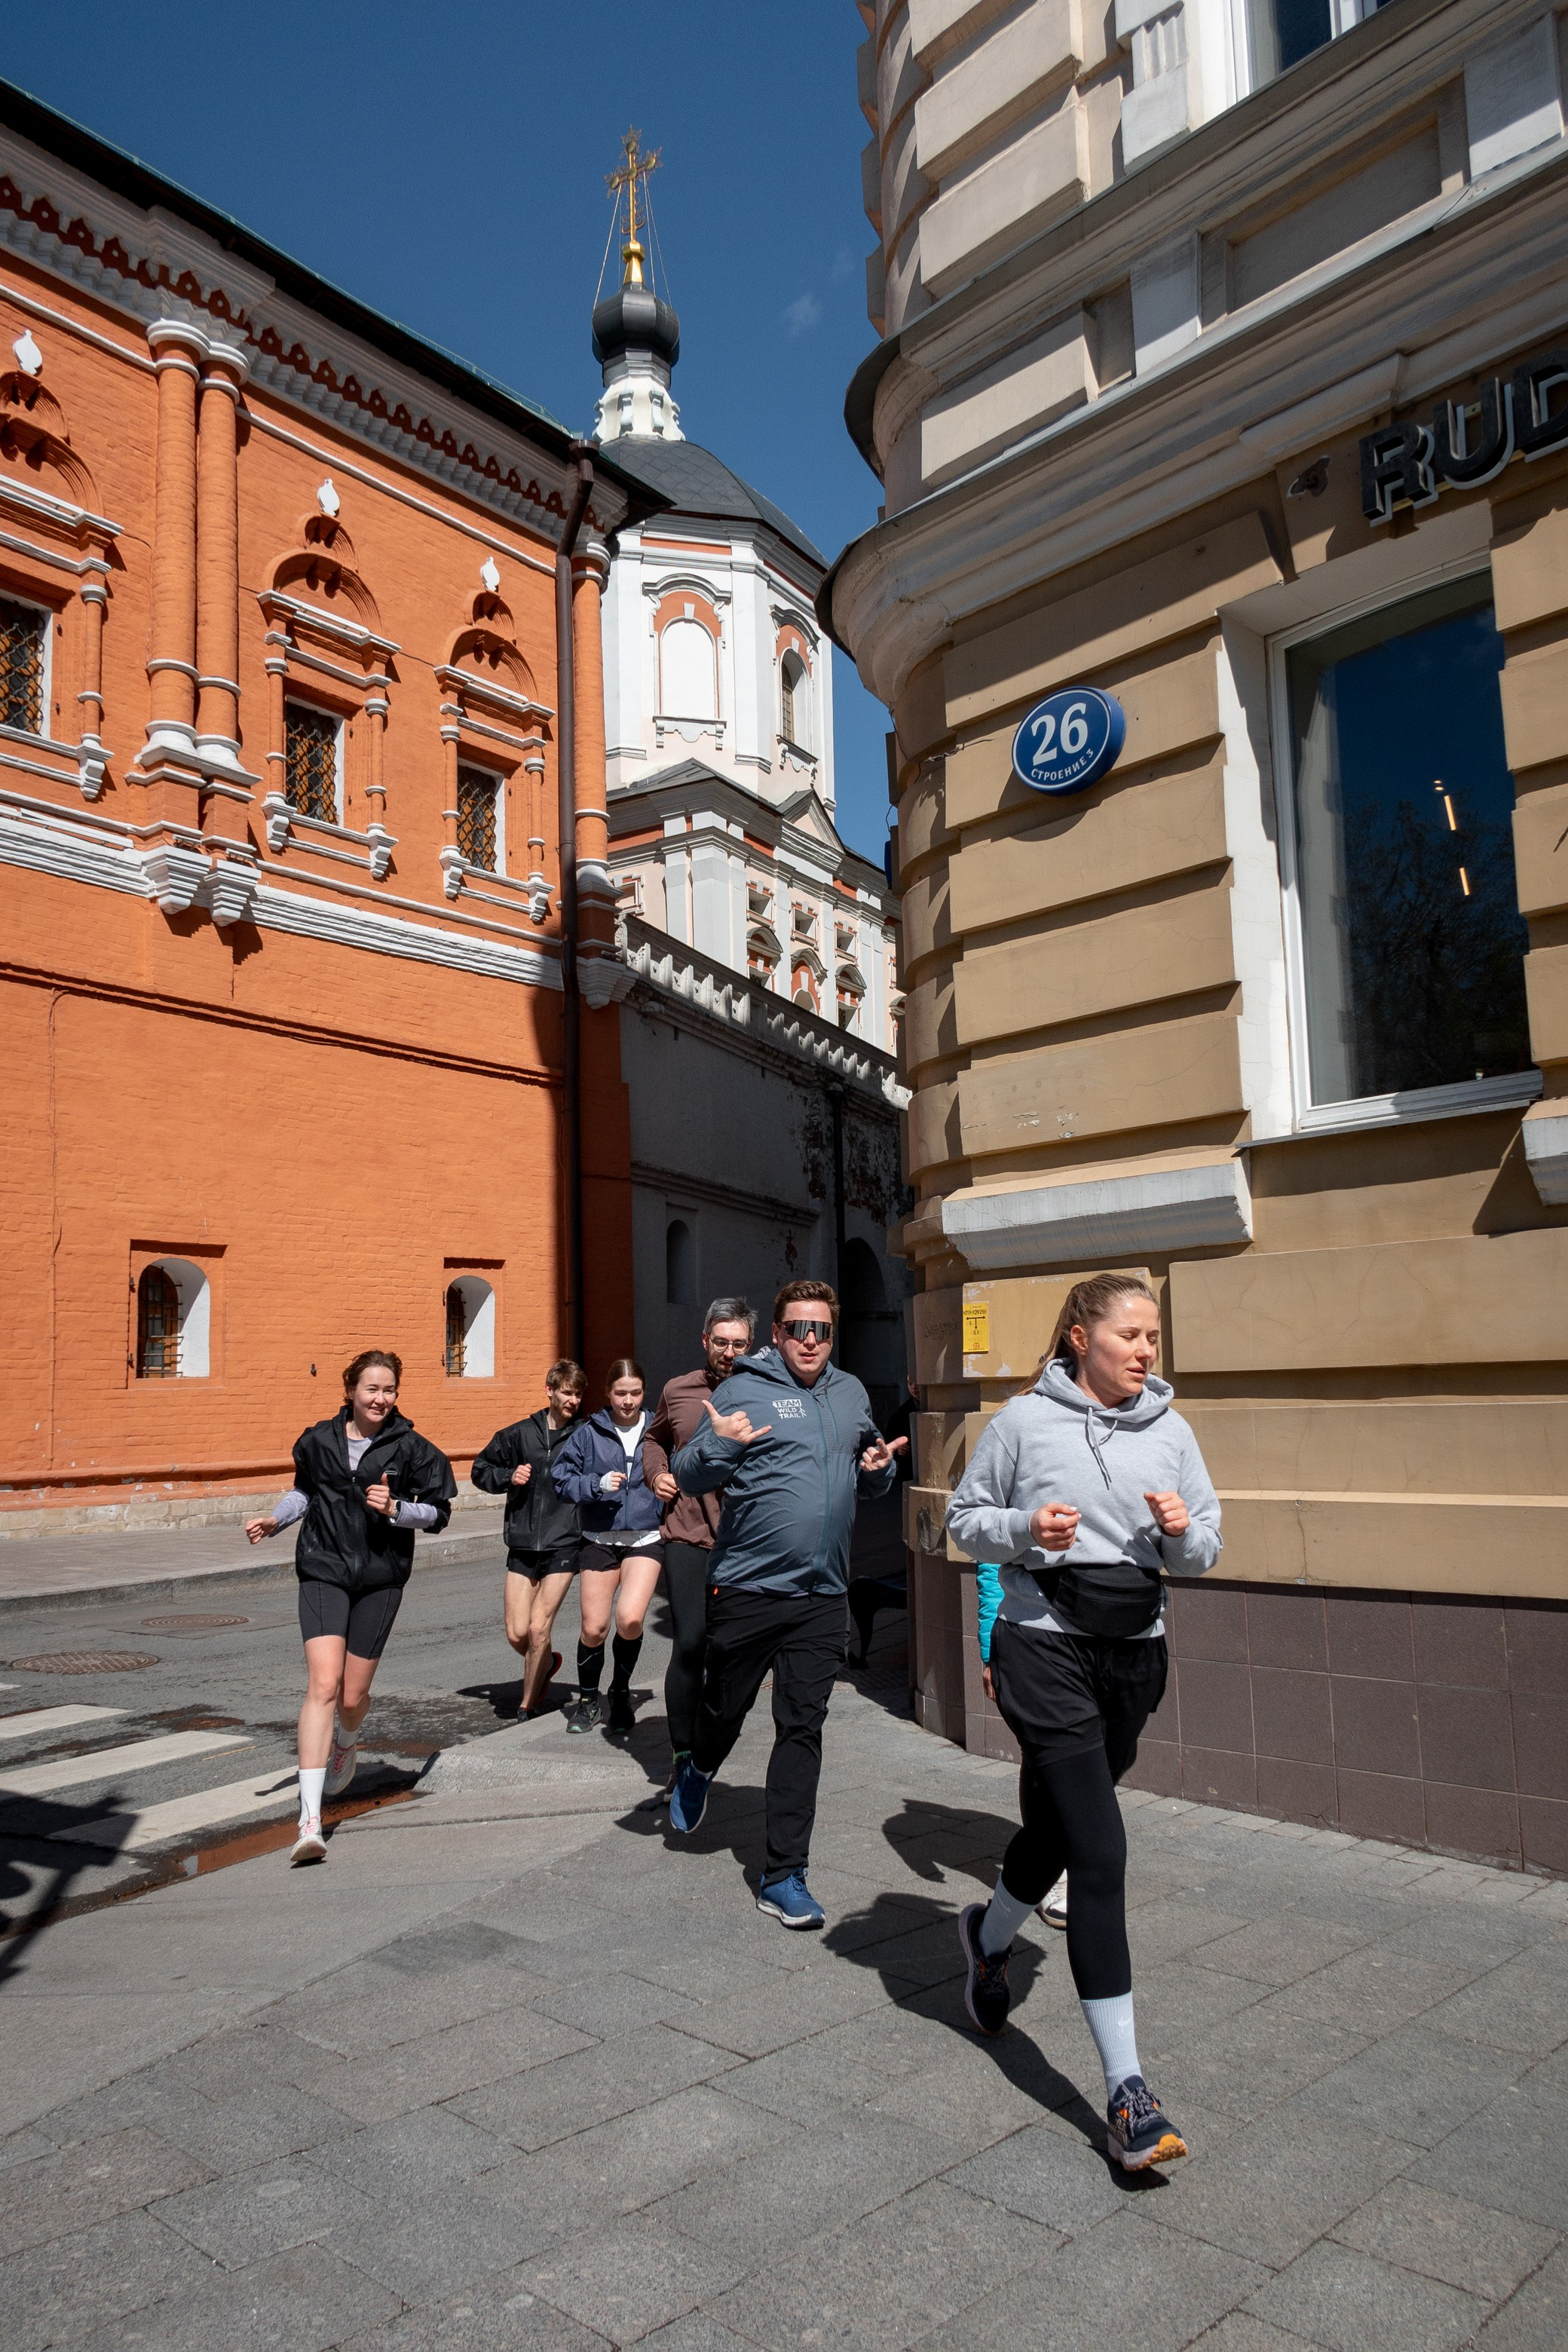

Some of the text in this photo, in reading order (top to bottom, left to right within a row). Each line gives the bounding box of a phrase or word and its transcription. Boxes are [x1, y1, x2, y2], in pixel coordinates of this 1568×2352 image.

[1031, 702, 1089, 767] 26
[1031, 749, 1094, 781] СТРОЕНИЕ 3
